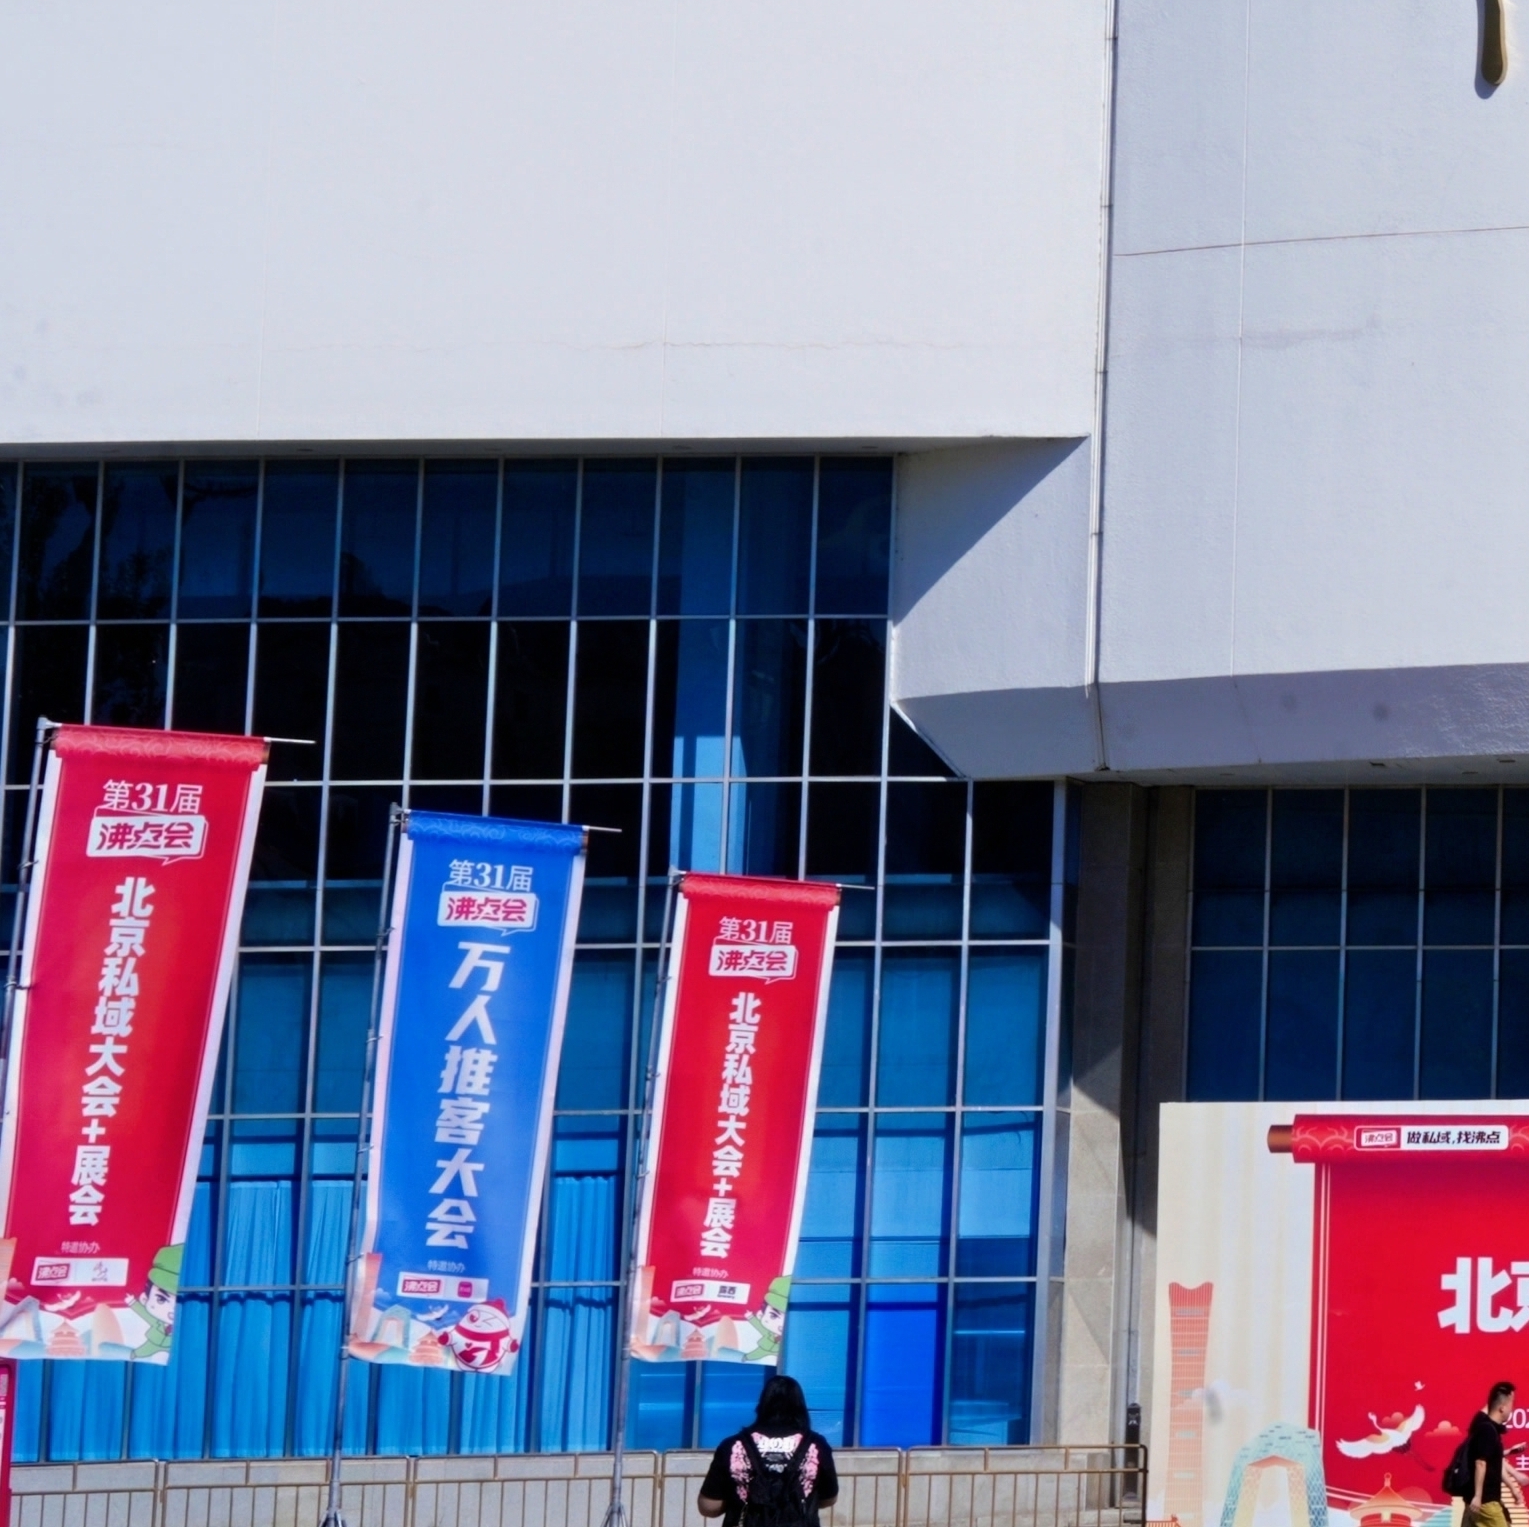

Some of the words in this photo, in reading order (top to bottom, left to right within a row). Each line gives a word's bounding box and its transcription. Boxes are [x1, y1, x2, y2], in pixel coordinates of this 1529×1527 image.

[101, 779, 204, 814] 第31届
[96, 820, 195, 852] 沸点会
[448, 859, 534, 891] 第31届
[445, 895, 528, 923] 沸点会
[719, 916, 793, 946] 第31届
[716, 949, 788, 974] 沸点会
[68, 876, 156, 1227] 北京私域大会+展会
[424, 940, 511, 1250] 万人推客大会
[699, 992, 762, 1260] 北京私域大会+展会
